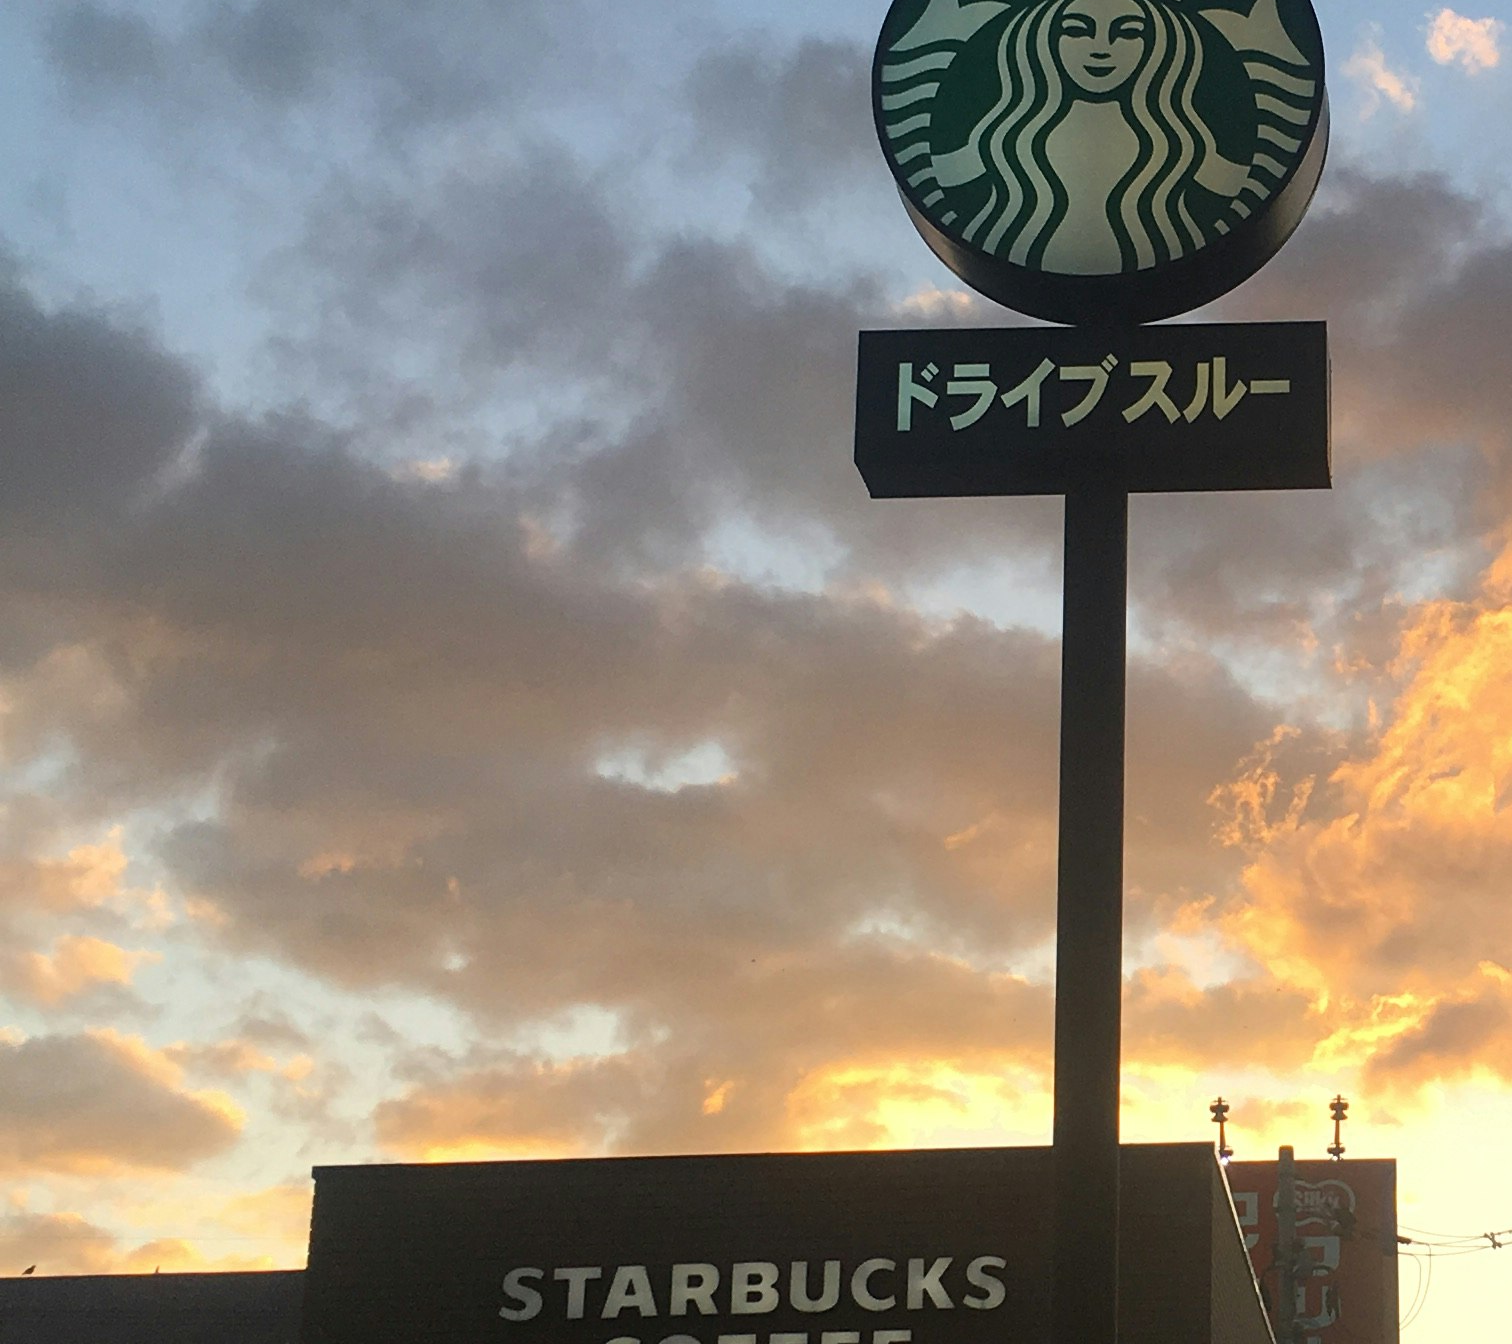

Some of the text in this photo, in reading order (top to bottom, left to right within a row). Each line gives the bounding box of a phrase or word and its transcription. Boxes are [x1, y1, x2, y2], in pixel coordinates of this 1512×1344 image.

[896, 353, 1291, 432] ドライブスルー
[499, 1255, 1008, 1322] STARBUCKS
